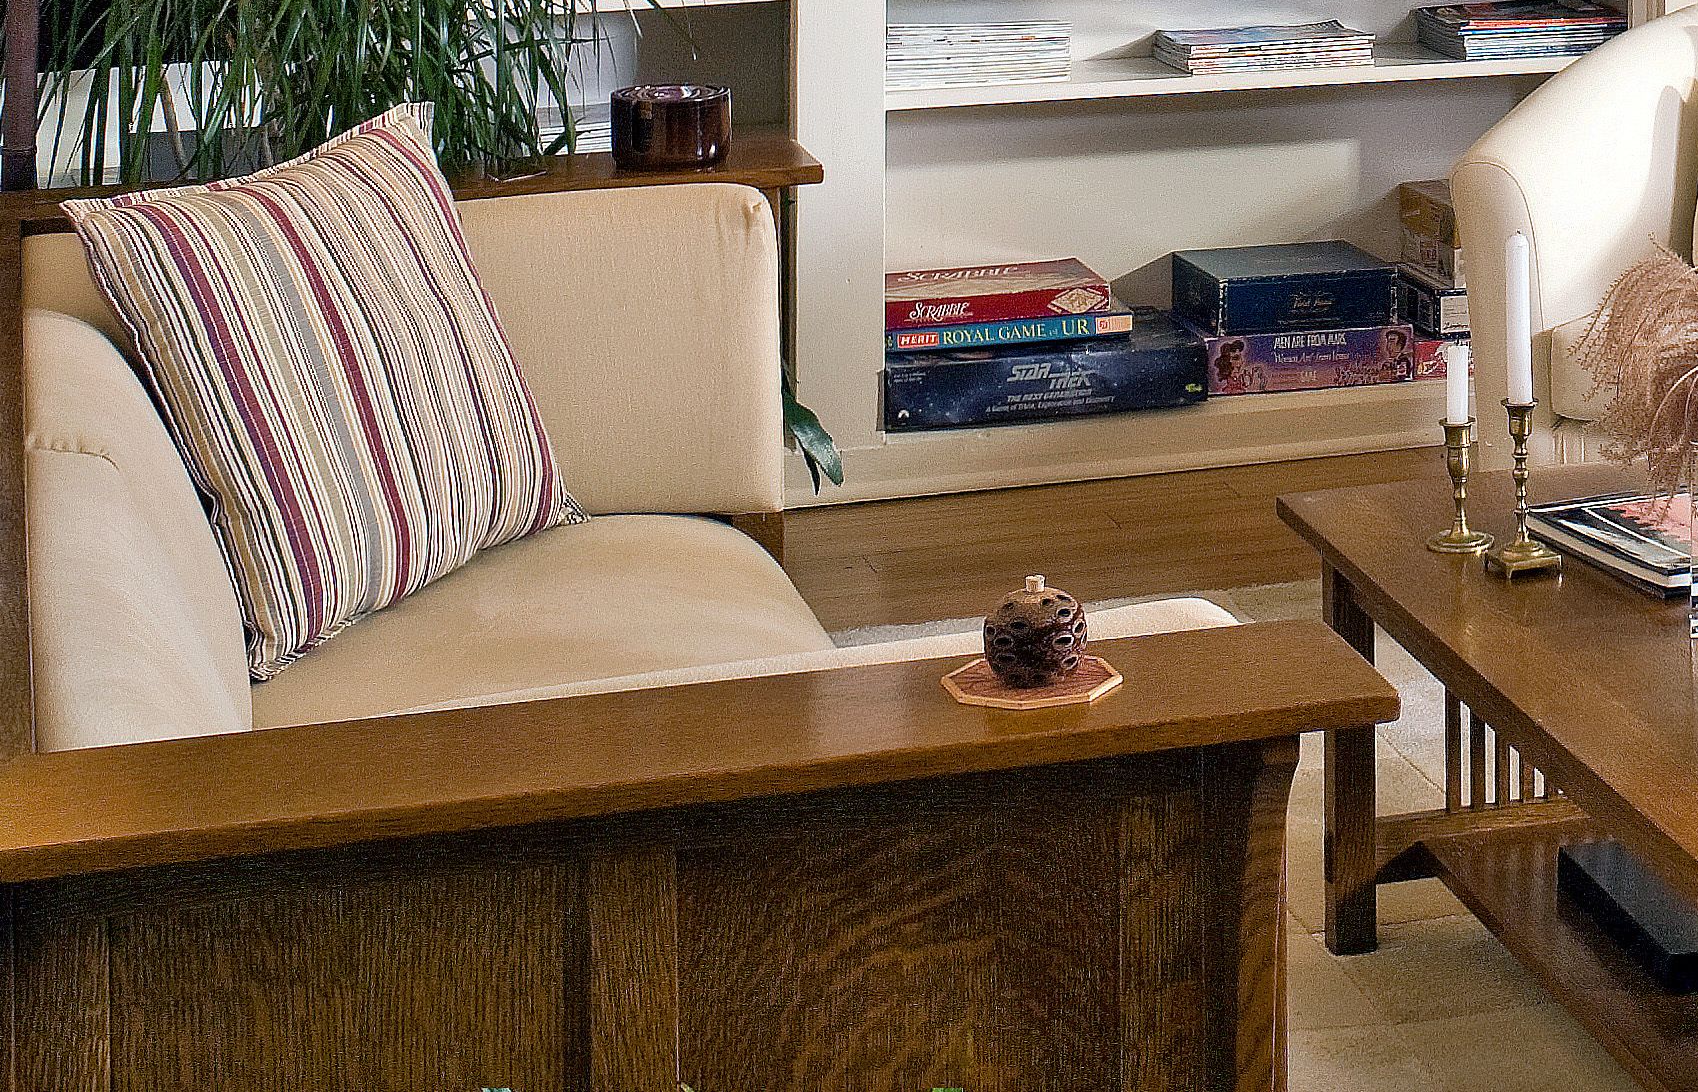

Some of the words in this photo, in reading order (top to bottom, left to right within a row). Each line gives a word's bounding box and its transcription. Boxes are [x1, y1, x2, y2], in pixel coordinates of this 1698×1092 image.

[909, 301, 971, 321] SCRABBLE
[943, 328, 996, 345] ROYAL
[998, 324, 1047, 339] GAME
[1062, 319, 1090, 335] UR
[1273, 335, 1291, 349] MEN
[1291, 335, 1306, 348] ARE
[1307, 334, 1326, 347] FROM
[1327, 332, 1347, 345] MARS
[1007, 362, 1052, 383] STAR
[1049, 369, 1098, 389] TREK
[1007, 394, 1022, 403] THE
[1022, 392, 1043, 402] NEXT
[1043, 388, 1093, 401] GENERATION
